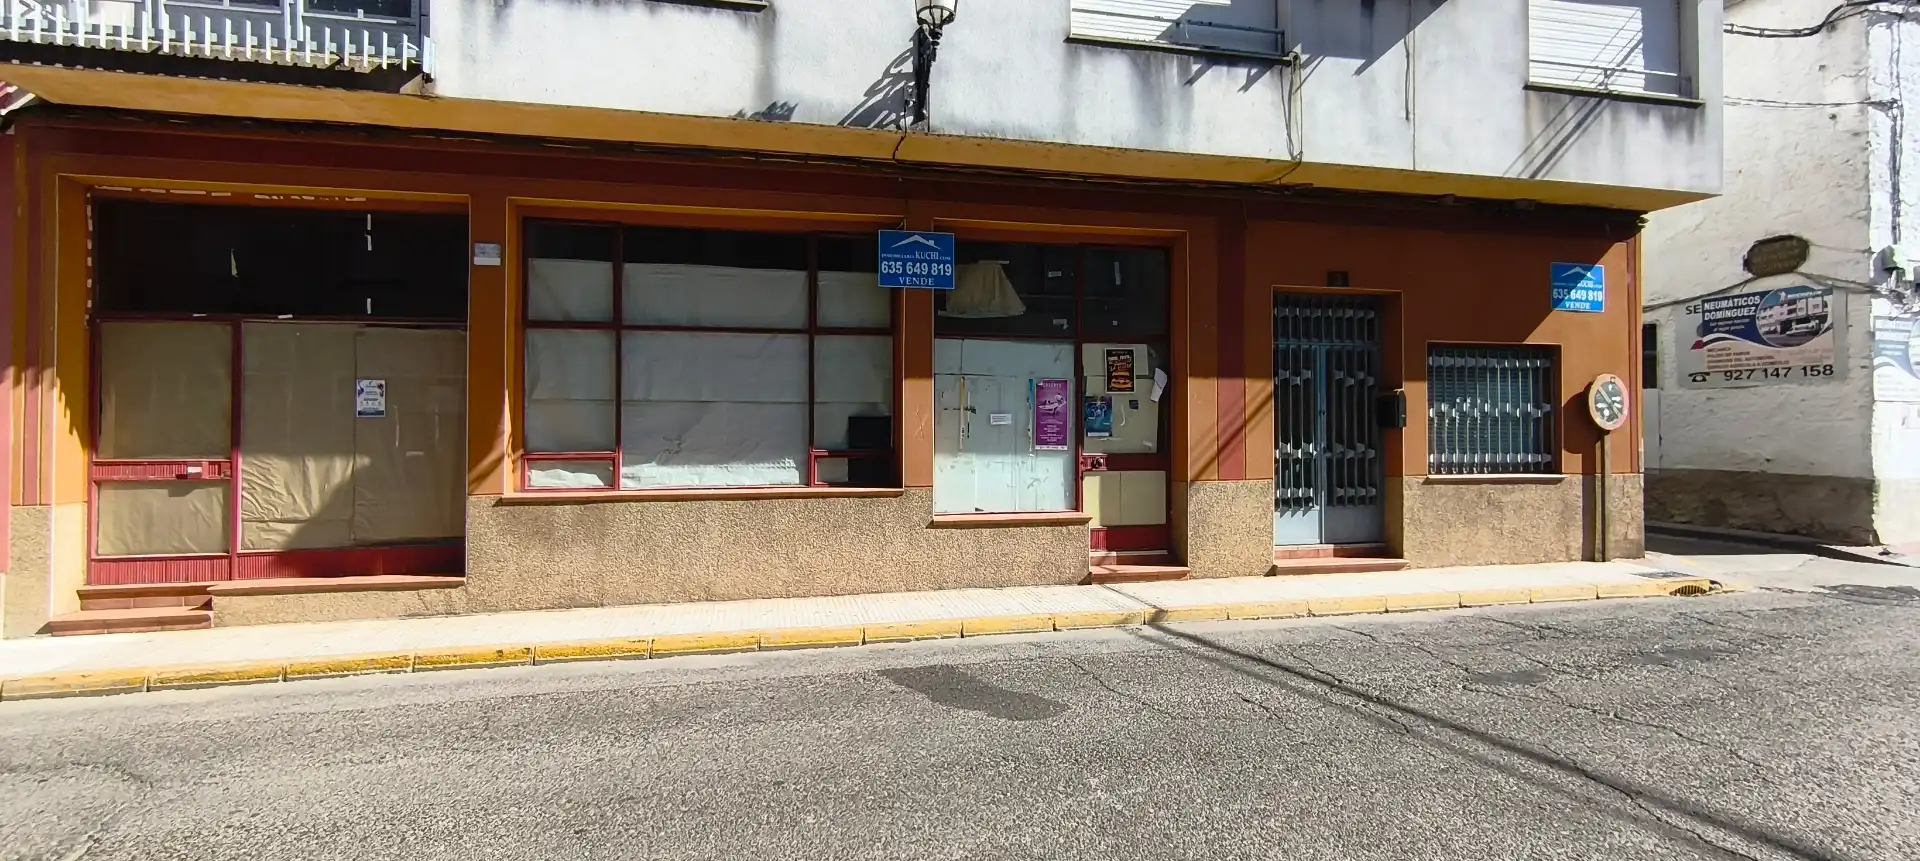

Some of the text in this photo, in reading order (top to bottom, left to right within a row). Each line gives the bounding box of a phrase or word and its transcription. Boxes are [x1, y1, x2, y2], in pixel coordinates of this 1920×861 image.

[881, 261, 952, 276] 635 649 819
[898, 276, 935, 286] VENDE
[1552, 288, 1569, 300] 635
[1570, 289, 1587, 300] 649
[1565, 301, 1591, 309] VENDE
[1704, 295, 1760, 310] NEUMÁTICOS
[1704, 306, 1756, 321] DOMÍNGUEZ
[1723, 368, 1756, 381] 927
[1762, 366, 1792, 379] 147
[1801, 364, 1834, 377] 158
